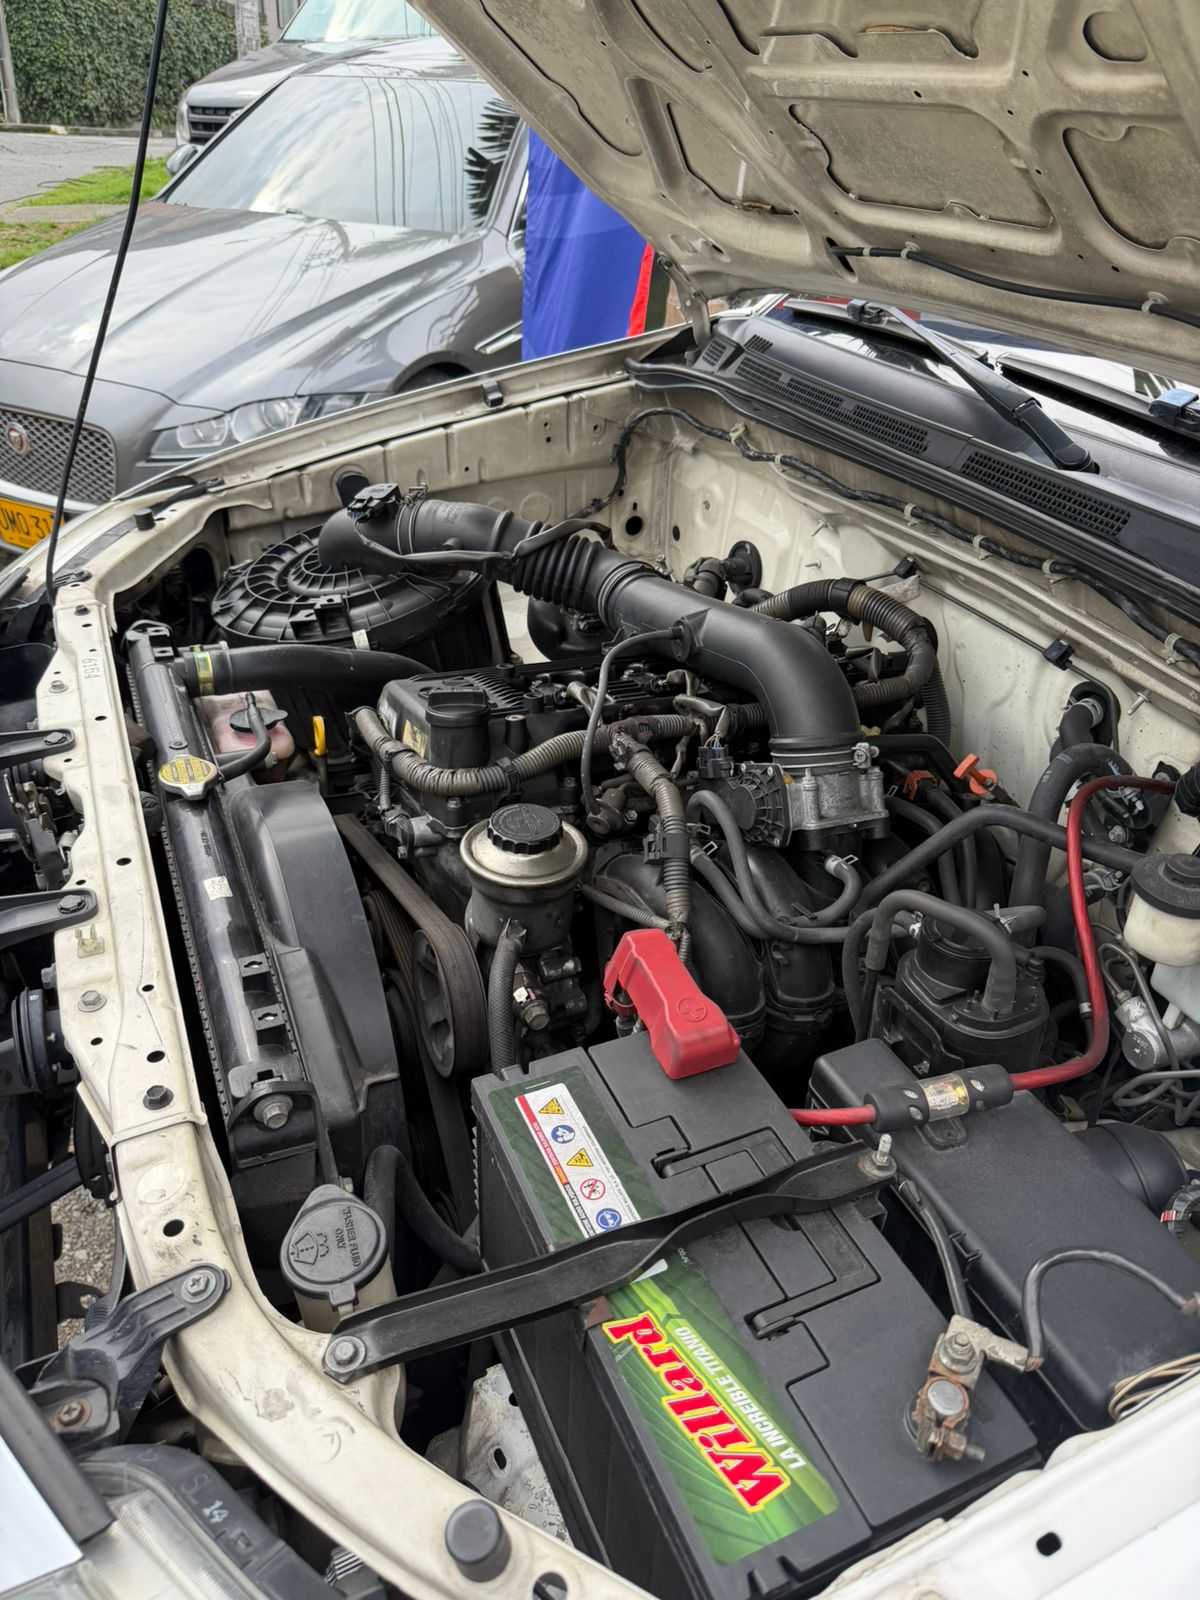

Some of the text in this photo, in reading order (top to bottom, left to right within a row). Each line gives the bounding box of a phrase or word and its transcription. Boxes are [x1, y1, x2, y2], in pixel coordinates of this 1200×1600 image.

[335, 1228, 347, 1250] ONLY
[342, 1205, 362, 1268] WASHER FLUID
[603, 1313, 791, 1511] Willard
[675, 1327, 807, 1470] LA INCREÍBLE TITANIO
